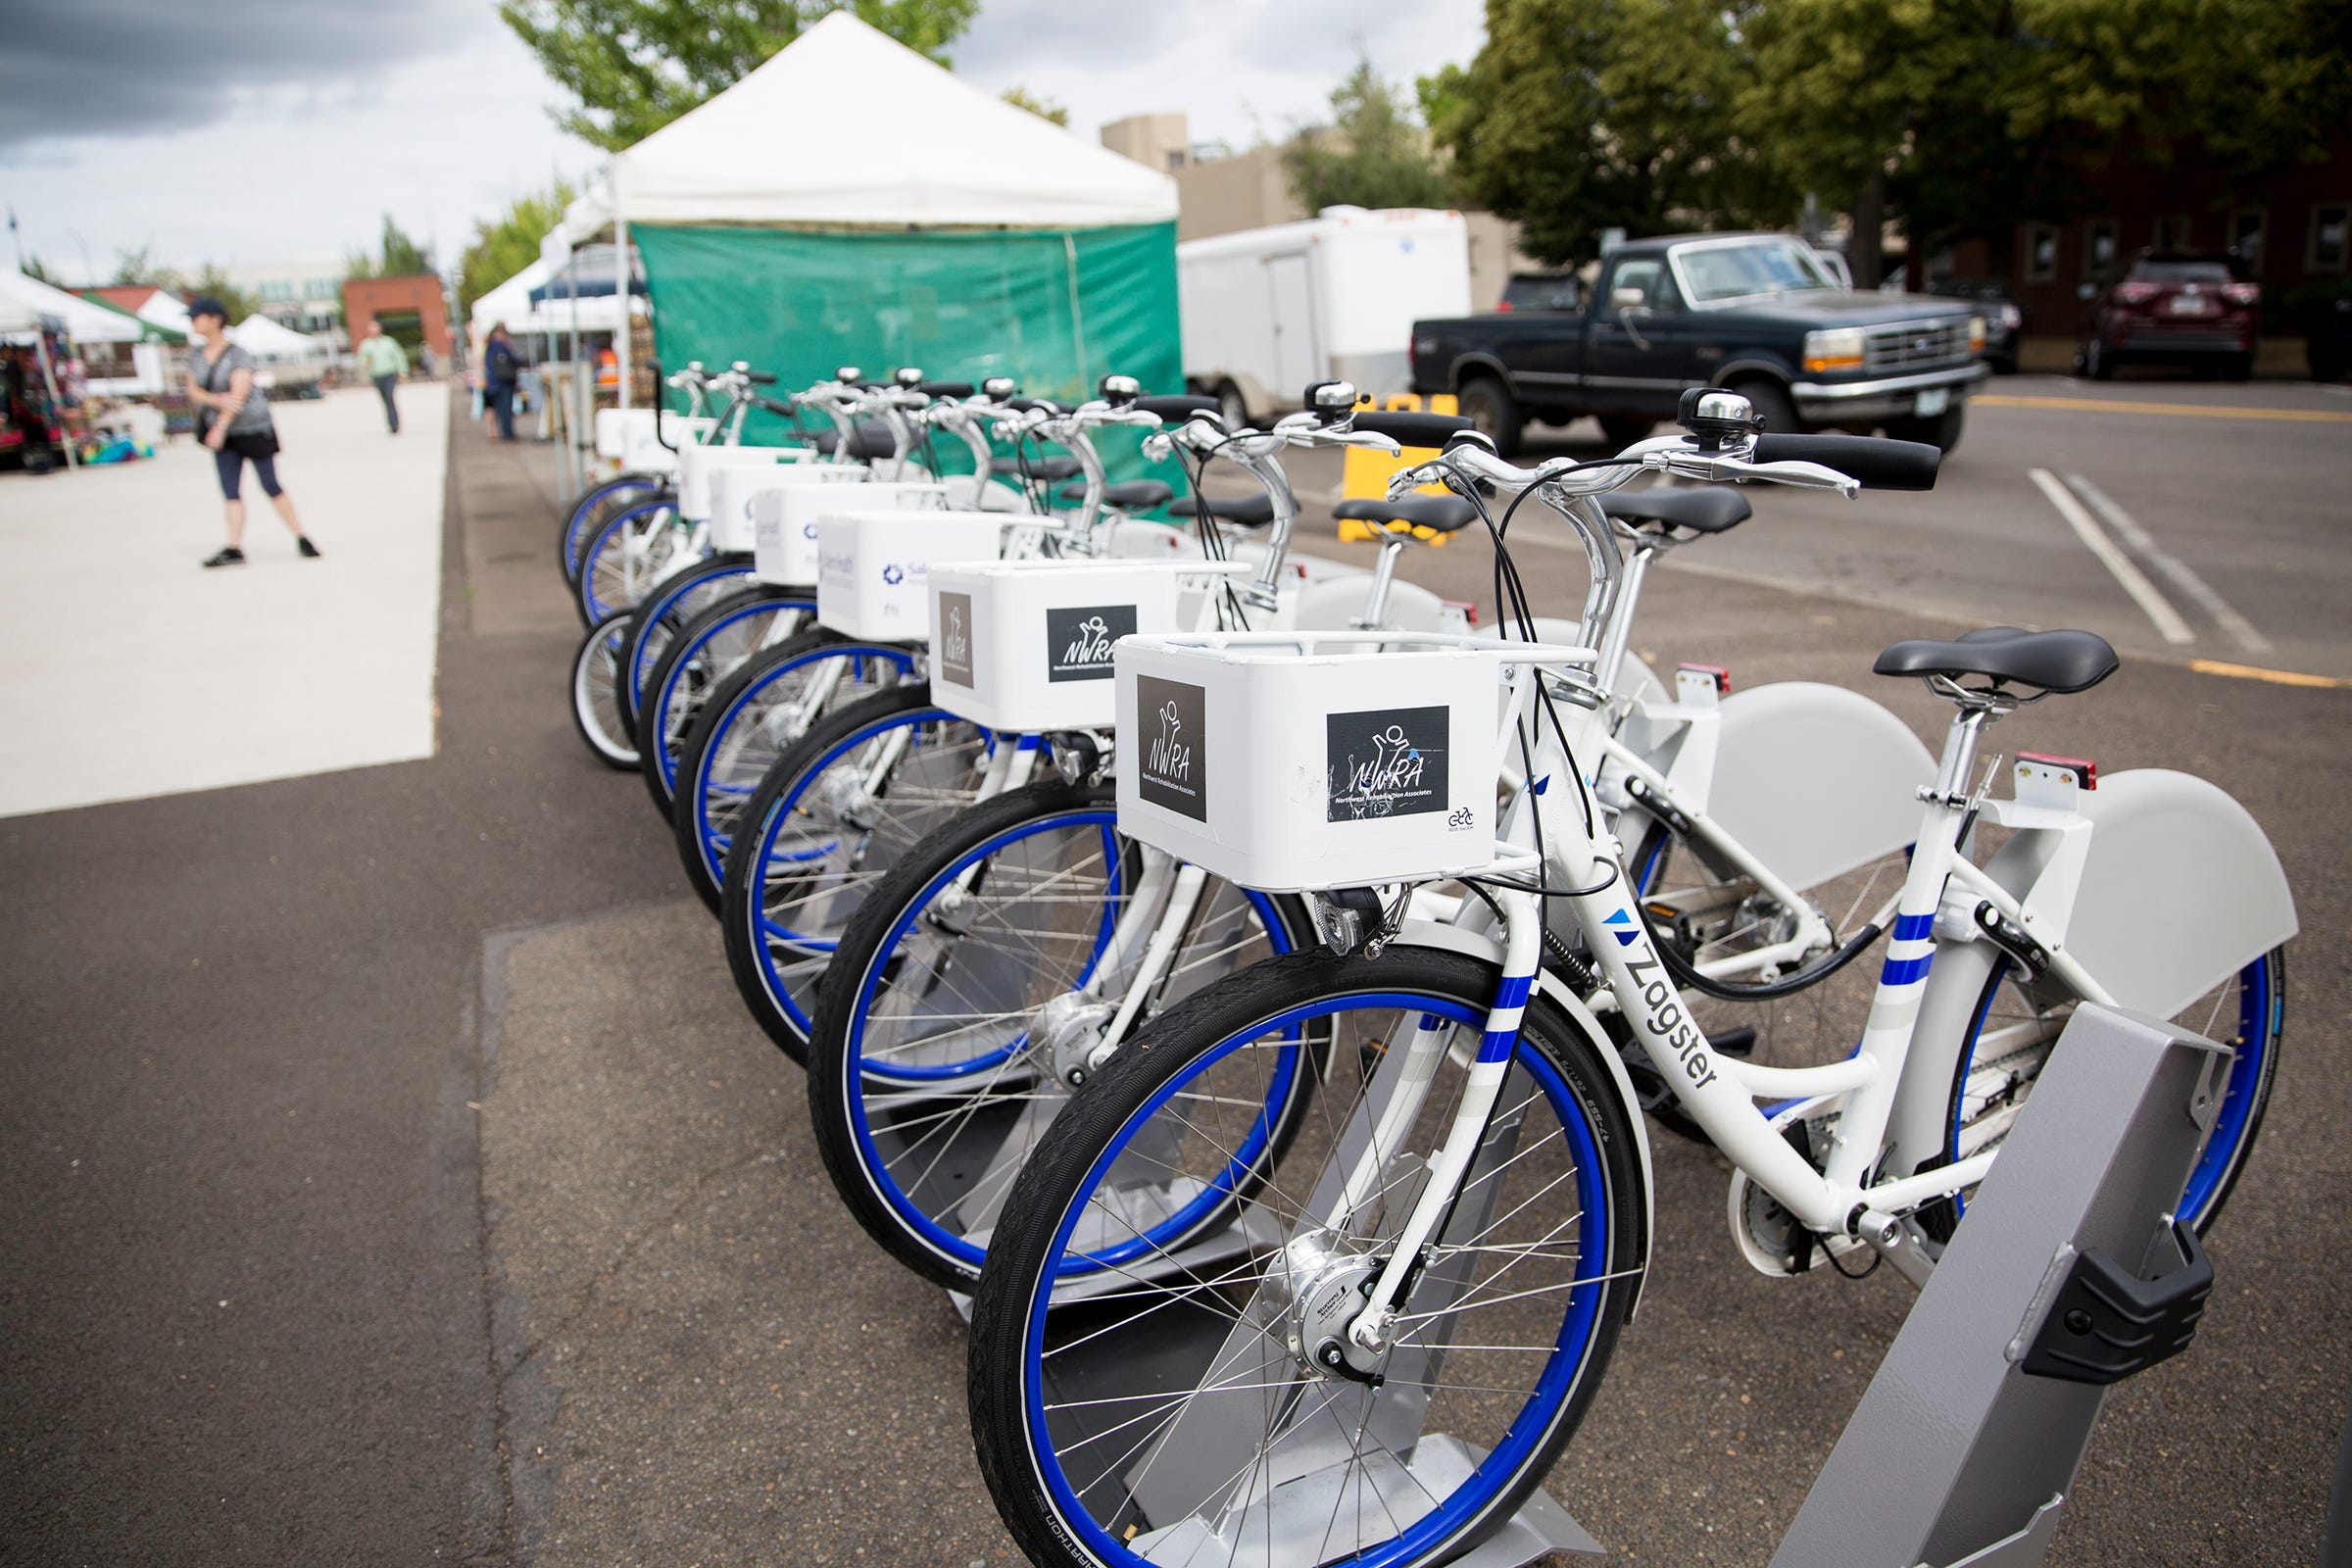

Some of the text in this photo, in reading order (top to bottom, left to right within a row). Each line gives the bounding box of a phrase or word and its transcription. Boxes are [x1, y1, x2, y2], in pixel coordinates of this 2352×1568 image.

[1149, 719, 1191, 782] NWRA
[1348, 743, 1425, 793] NWRA
[1404, 789, 1433, 798] Associates
[1624, 941, 1718, 1089] Zagster
[1046, 1514, 1097, 1568] ARATHON
